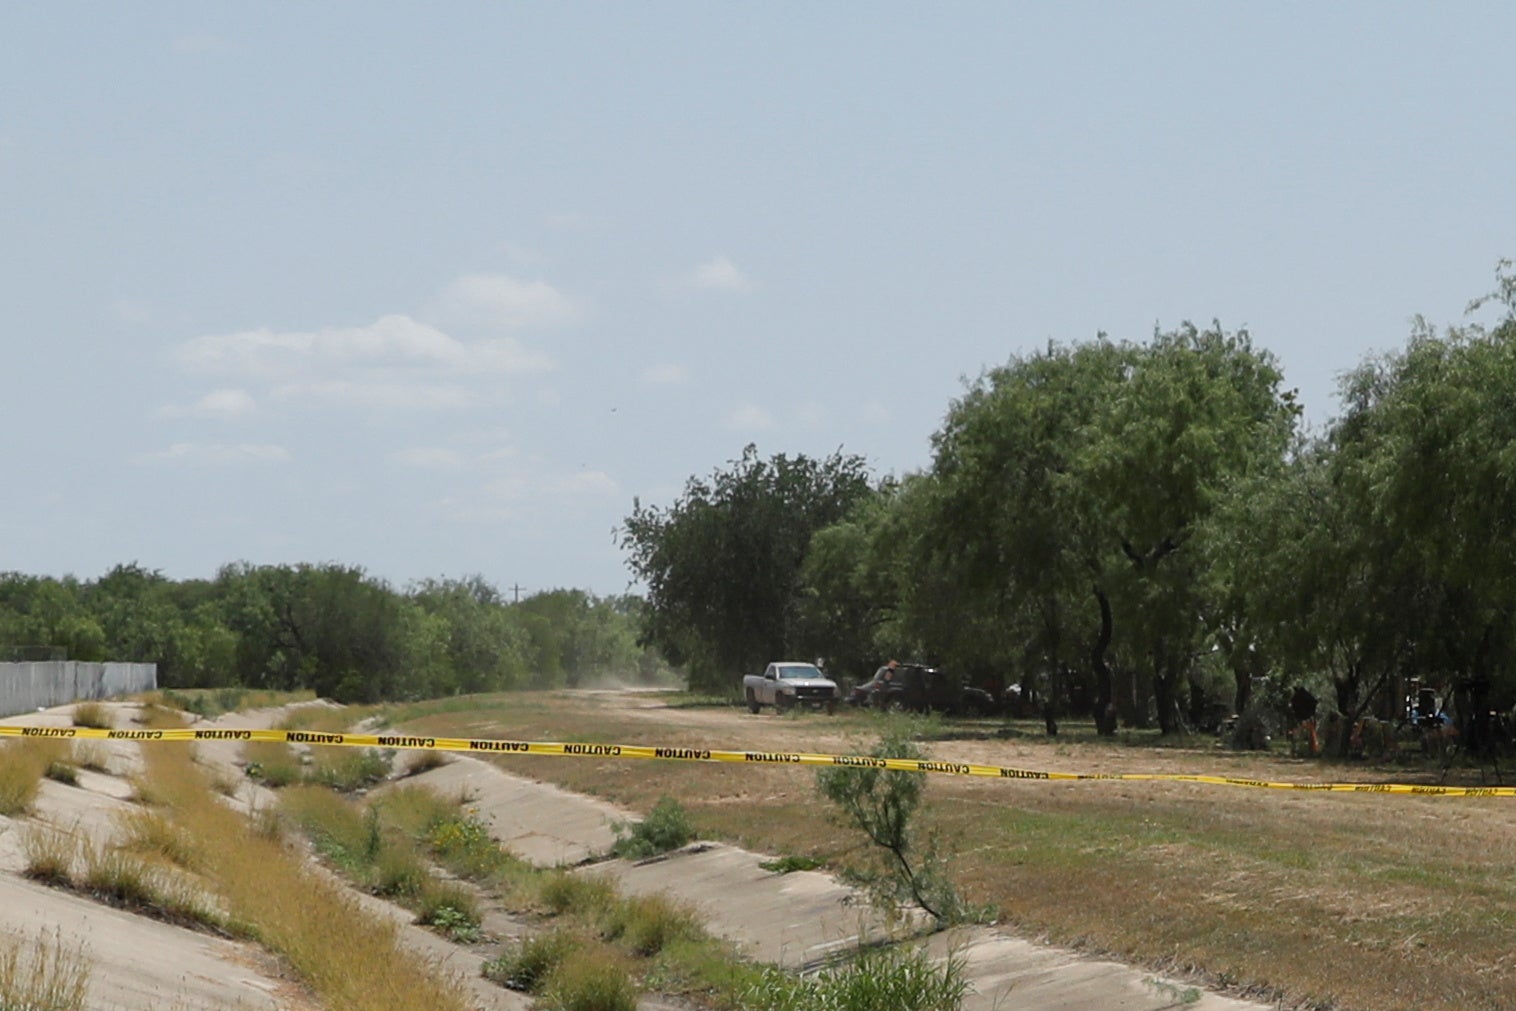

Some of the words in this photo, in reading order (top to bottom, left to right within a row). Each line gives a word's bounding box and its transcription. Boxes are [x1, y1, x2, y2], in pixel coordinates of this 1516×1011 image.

[21, 727, 76, 737] CAUTION
[107, 729, 163, 739] CAUTION
[194, 730, 251, 740] CAUTION
[286, 732, 344, 744] CAUTION
[377, 737, 435, 748] CAUTION
[469, 741, 529, 752] CAUTION
[563, 744, 621, 756] CAUTION
[654, 748, 711, 759] CAUTION
[745, 752, 801, 763] CAUTION
[832, 756, 887, 768] CAUTION
[917, 761, 970, 774] CAUTION
[1000, 768, 1049, 779] CAUTION
